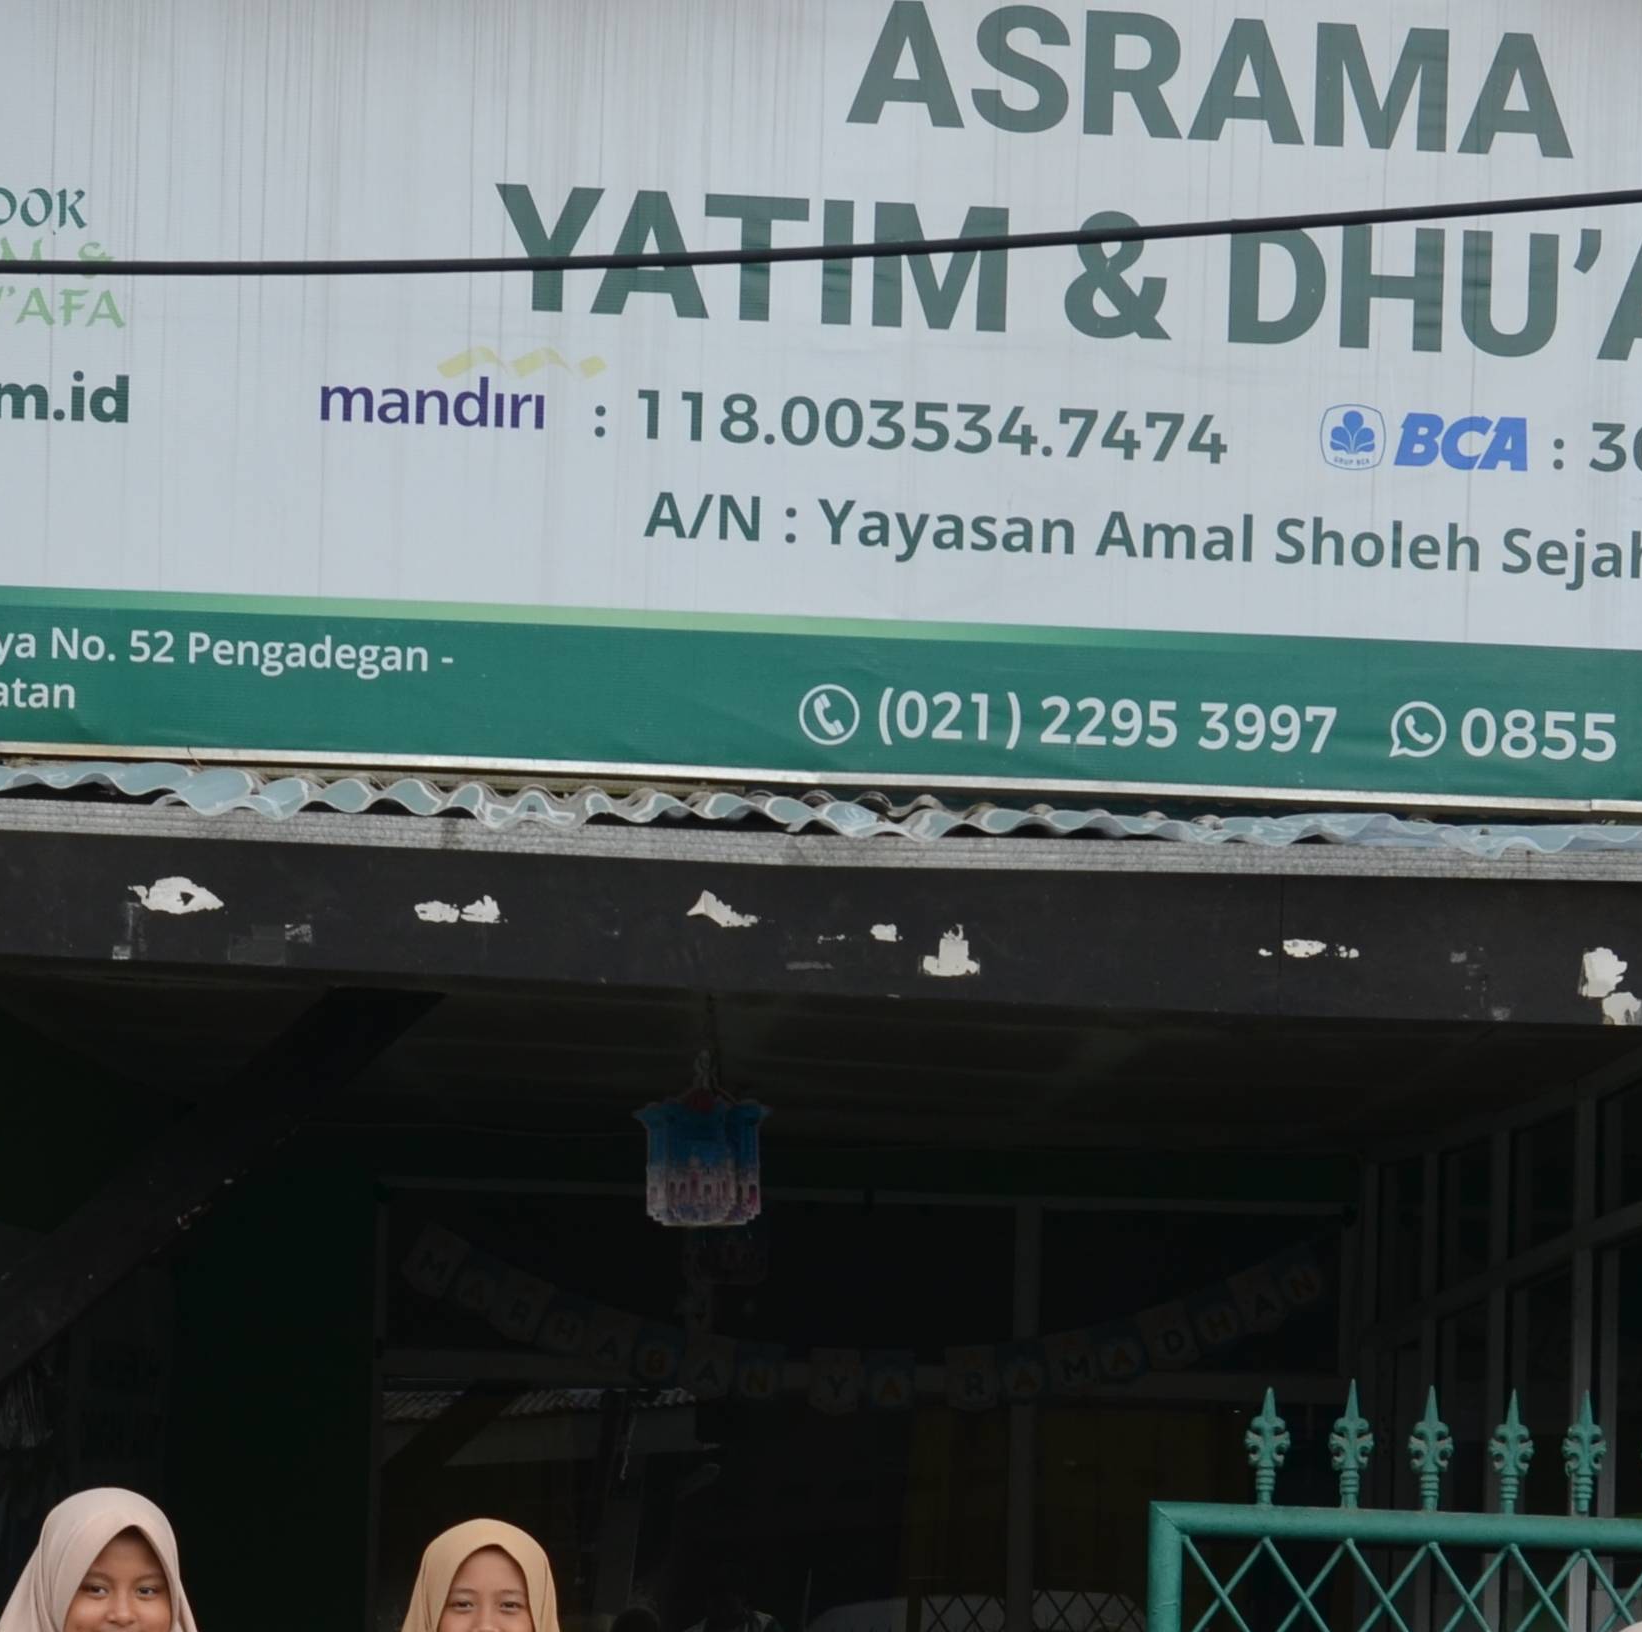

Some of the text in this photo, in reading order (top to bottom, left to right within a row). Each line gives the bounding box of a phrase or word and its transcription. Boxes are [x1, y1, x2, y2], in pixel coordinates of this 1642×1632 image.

[845, 0, 1574, 159] ASRAMA
[494, 183, 1010, 333] YATIM
[1063, 210, 1172, 341] &
[637, 389, 1228, 465] 118.003534.7474
[1393, 412, 1528, 472] BCA
[643, 491, 761, 542] A/N
[817, 498, 1075, 563] Yayasan
[1095, 510, 1254, 563] Amal
[1274, 516, 1480, 572] Sholeh
[51, 626, 117, 662] No.
[129, 629, 175, 663] 52
[188, 631, 429, 680] Pengadegan
[878, 687, 1337, 754] (021) 2295 3997
[1460, 707, 1617, 762] 0855
